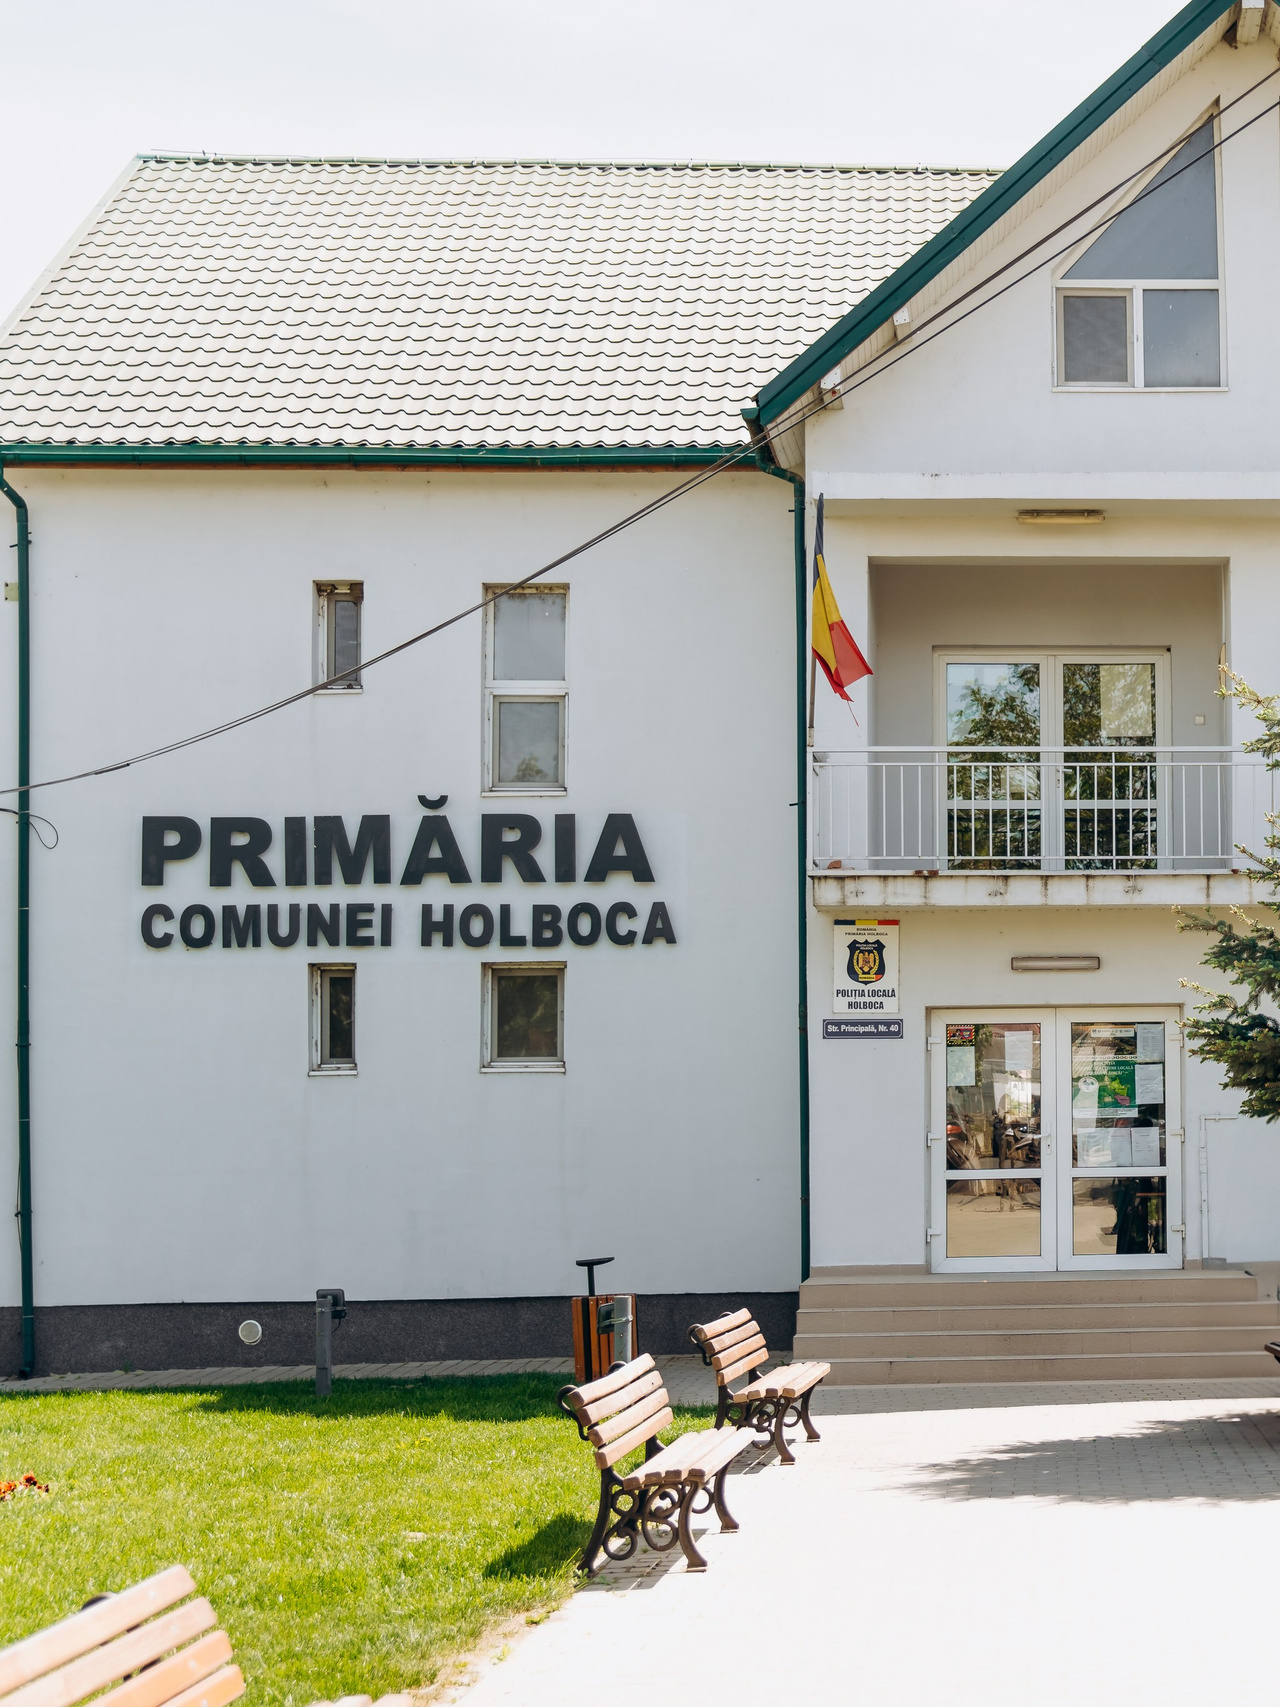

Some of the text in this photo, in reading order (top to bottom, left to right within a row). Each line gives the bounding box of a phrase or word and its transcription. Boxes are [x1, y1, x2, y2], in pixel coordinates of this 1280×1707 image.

[141, 794, 656, 888] PRIMĂRIA
[141, 901, 677, 950] COMUNEI HOLBOCA
[836, 988, 896, 999] POLIȚIA LOCALĂ
[848, 1001, 884, 1010] HOLBOCA
